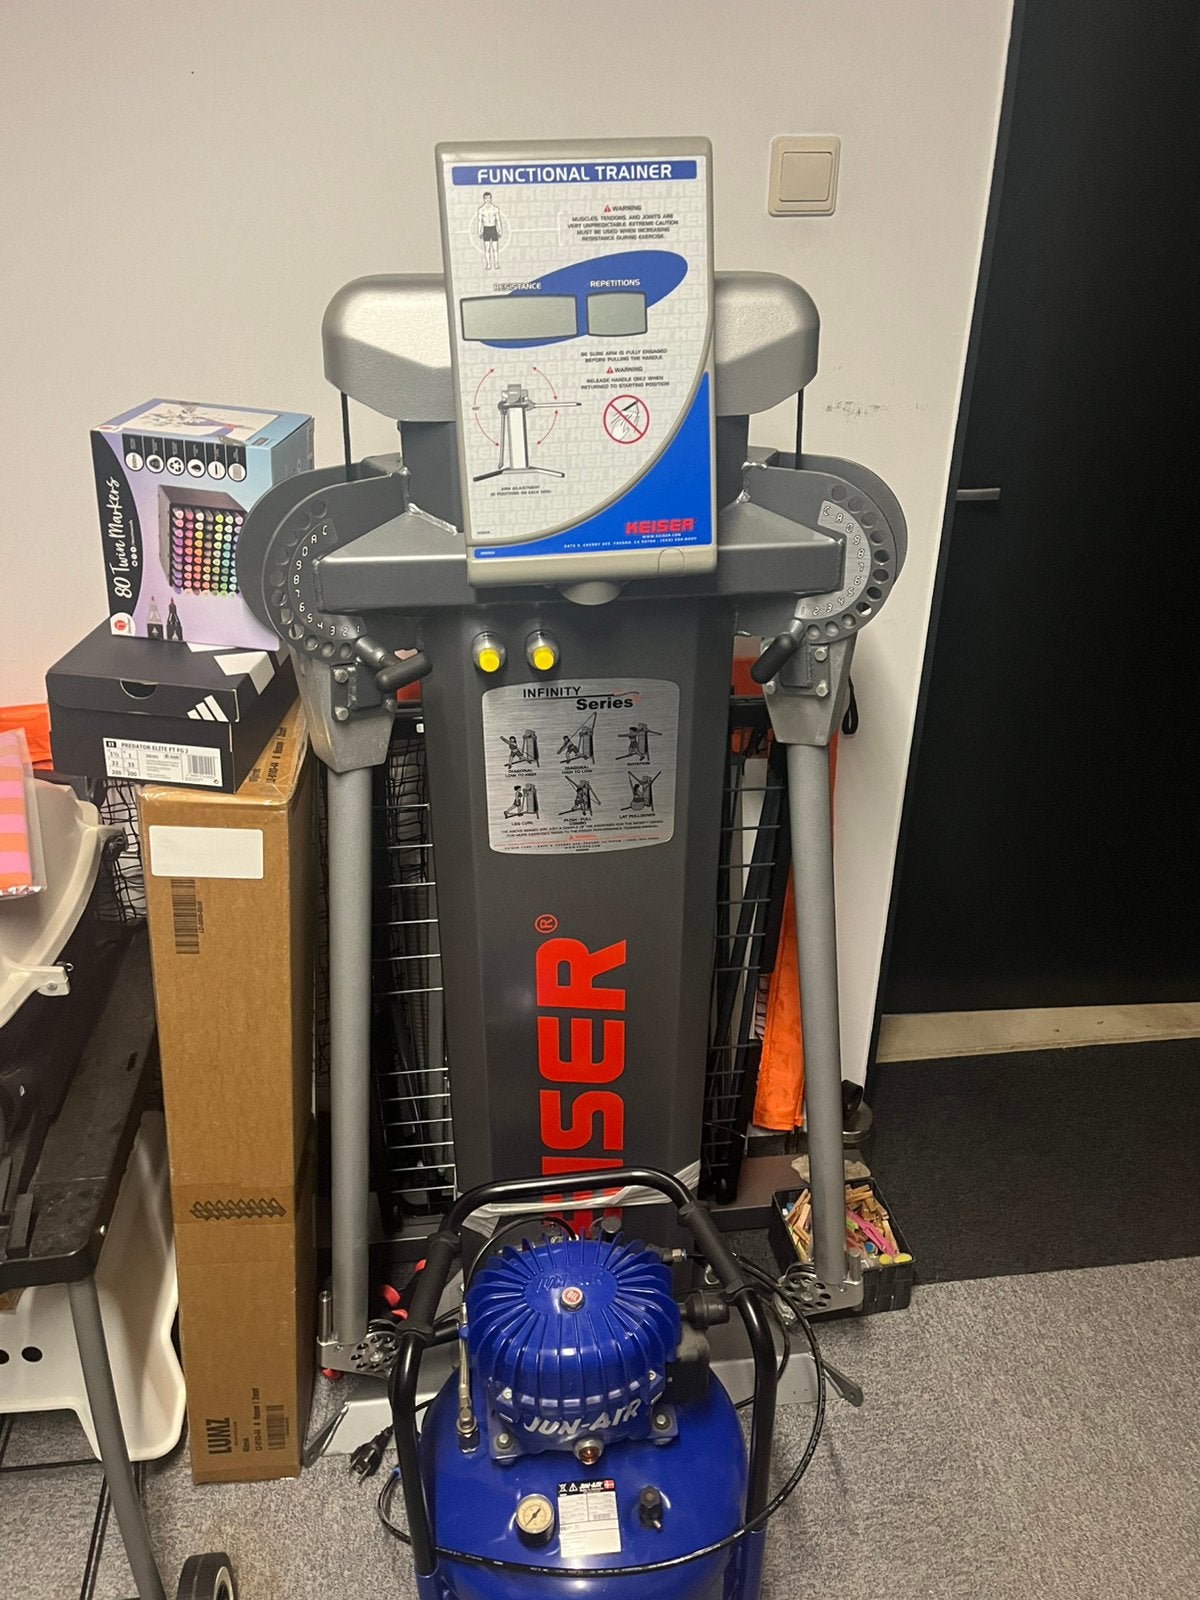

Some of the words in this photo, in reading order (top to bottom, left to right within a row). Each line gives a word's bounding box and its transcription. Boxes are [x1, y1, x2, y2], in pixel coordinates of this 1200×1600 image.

[477, 166, 590, 184] FUNCTIONAL
[595, 164, 673, 180] TRAINER
[493, 282, 542, 291] RESISTANCE
[590, 278, 641, 288] REPETITIONS
[105, 477, 121, 538] Markers
[322, 524, 329, 536] C
[625, 518, 695, 535] KEISER
[310, 534, 318, 544] A
[852, 534, 861, 546] 9
[110, 540, 129, 575] Twin
[857, 547, 865, 559] 8
[295, 559, 302, 571] 9
[293, 574, 300, 585] 8
[854, 575, 862, 586] 6
[112, 576, 132, 599] 80
[294, 588, 300, 598] 7
[299, 601, 306, 612] 6
[306, 612, 313, 623] 5
[316, 621, 324, 630] 4
[329, 625, 336, 636] 3
[342, 626, 348, 637] 2
[523, 686, 581, 698] INFINITY
[576, 697, 634, 711] Series
[523, 1398, 641, 1435] JUN-AIR
[206, 1417, 232, 1455] LUMZ
